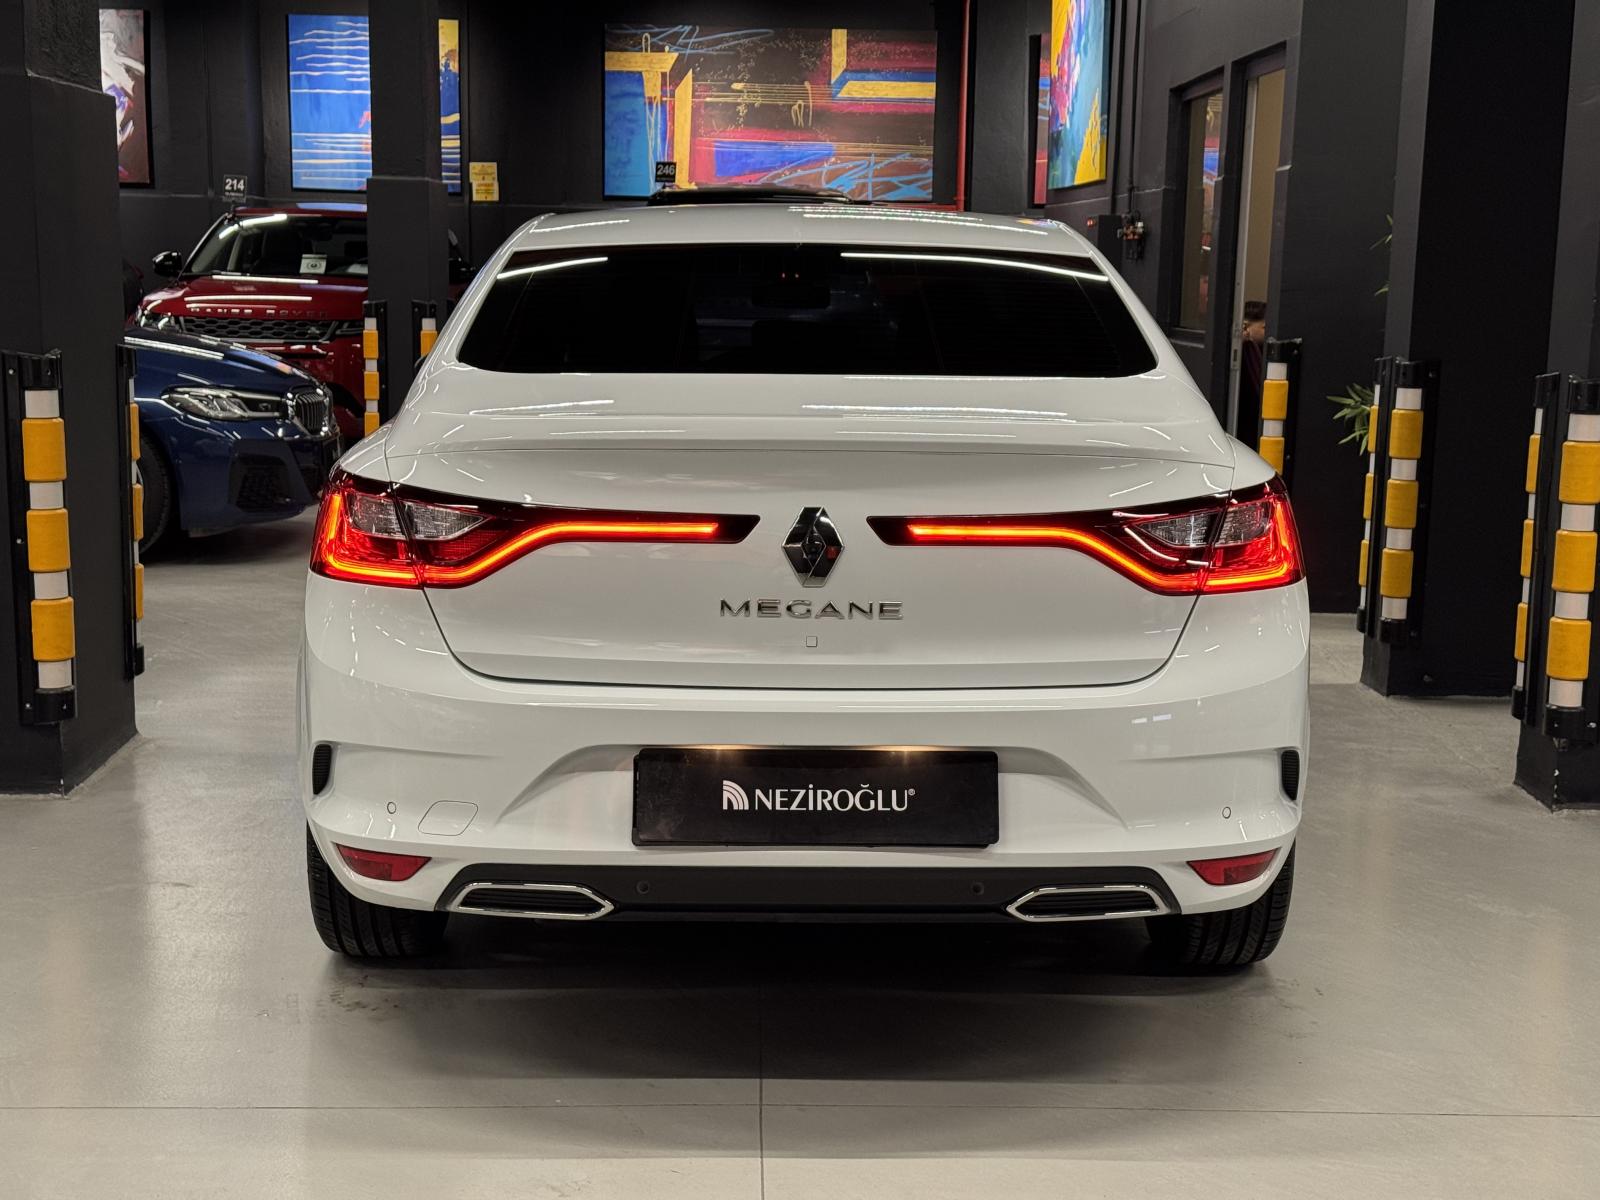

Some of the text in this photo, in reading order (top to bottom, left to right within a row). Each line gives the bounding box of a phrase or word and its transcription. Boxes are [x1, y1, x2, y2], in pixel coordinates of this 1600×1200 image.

[657, 164, 675, 175] 246
[225, 178, 244, 191] 214
[720, 599, 903, 620] MEGANE
